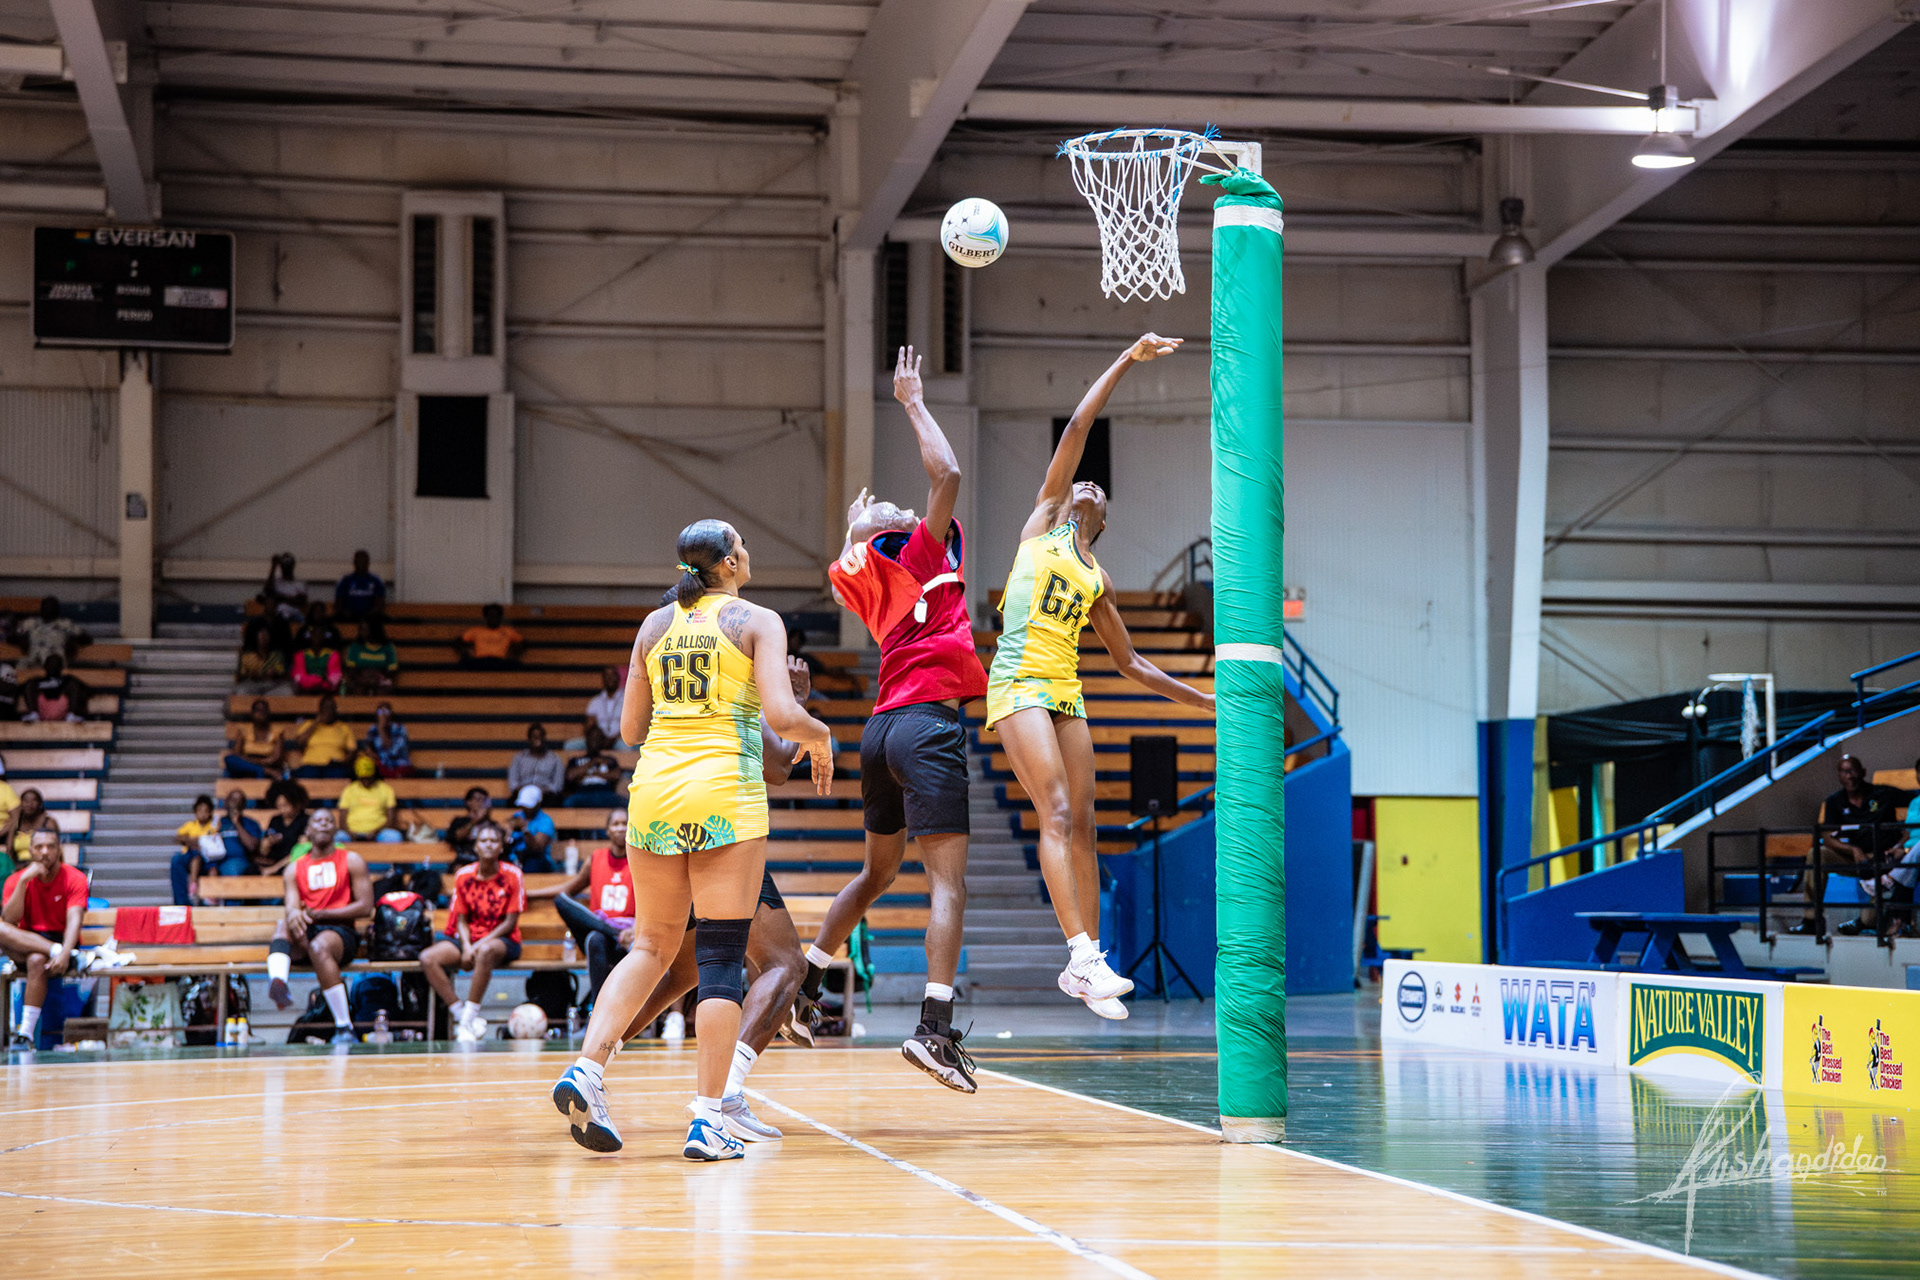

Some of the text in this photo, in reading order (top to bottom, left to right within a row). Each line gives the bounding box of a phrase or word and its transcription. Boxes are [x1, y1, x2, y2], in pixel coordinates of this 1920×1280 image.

[95, 230, 196, 248] EVERSAN
[948, 241, 997, 257] GILBERT
[1039, 570, 1085, 631] GA
[664, 635, 718, 651] G. ALLISON
[659, 651, 711, 703] GS
[1500, 979, 1597, 1053] WATA
[1632, 988, 1758, 1070] NATURE VALLEY
[1821, 1028, 1831, 1041] The
[1879, 1033, 1890, 1046] The
[1821, 1042, 1833, 1055] Best
[1880, 1047, 1893, 1060] Best
[1821, 1056, 1842, 1069] Dressed
[1880, 1062, 1903, 1076] Dressed
[1821, 1069, 1842, 1083] Chicken
[1880, 1075, 1902, 1090] Chicken
